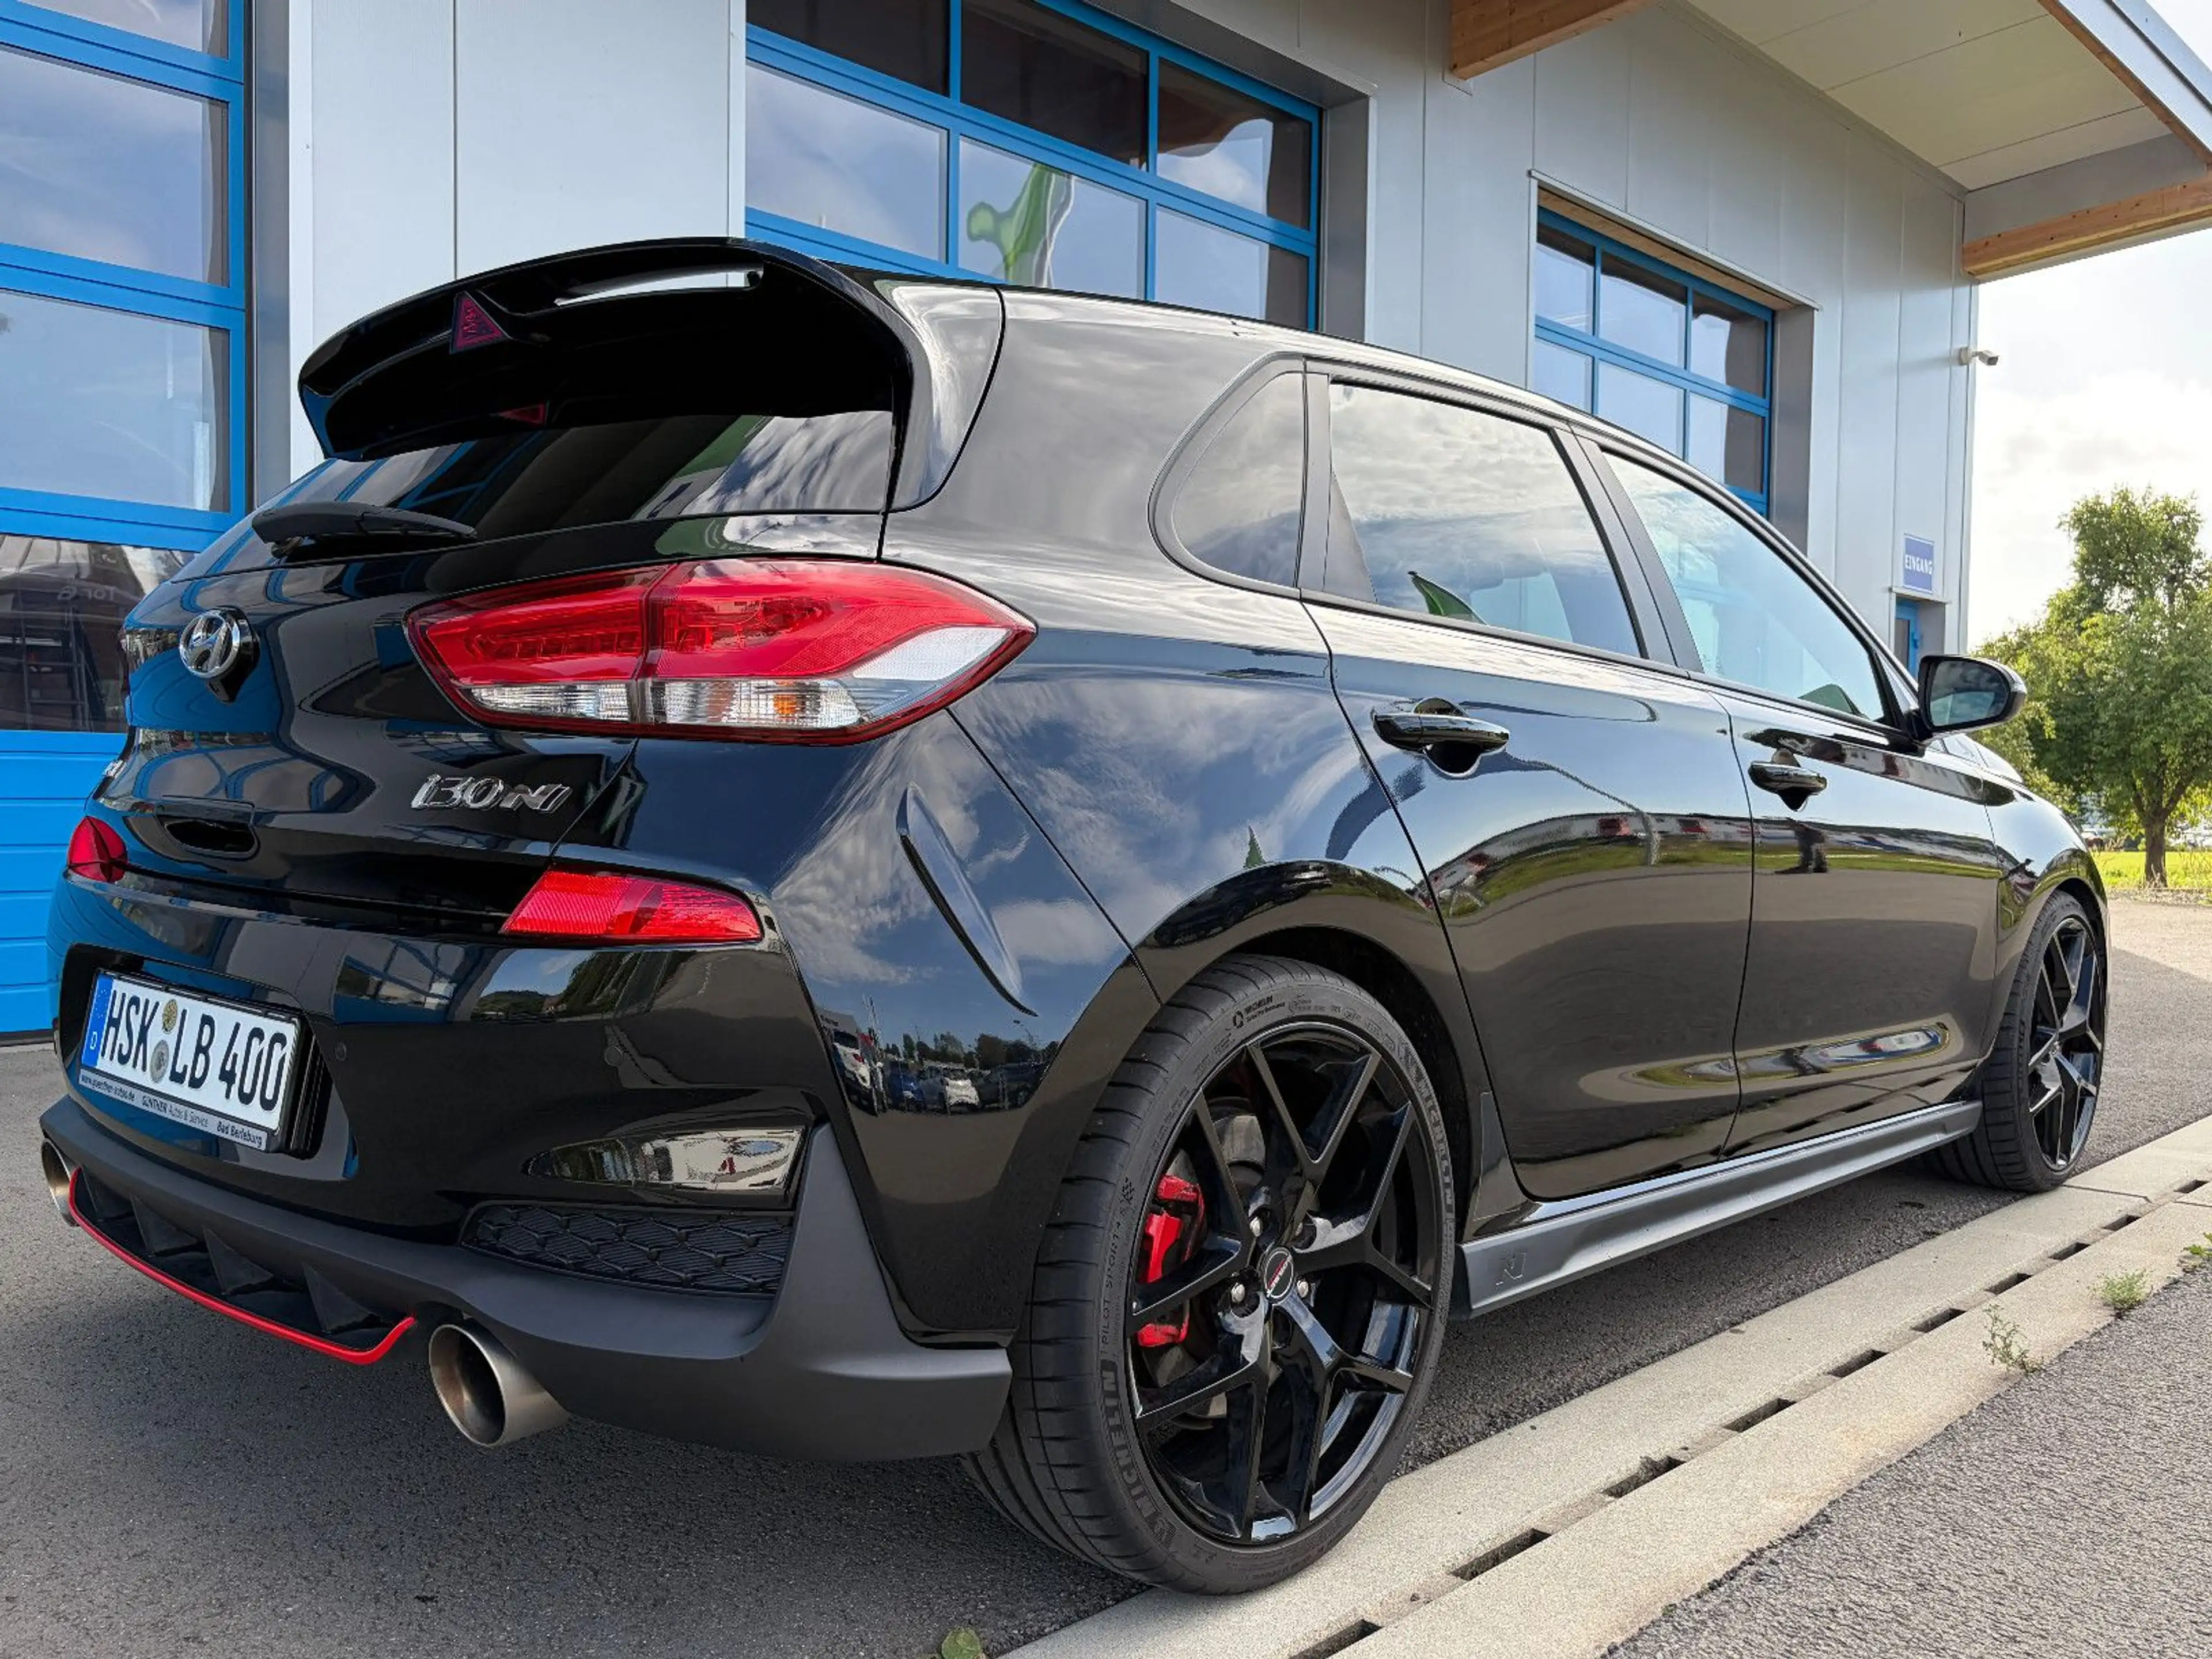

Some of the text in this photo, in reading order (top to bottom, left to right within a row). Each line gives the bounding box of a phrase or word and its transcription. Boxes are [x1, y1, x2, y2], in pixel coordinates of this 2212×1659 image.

[1905, 554, 1932, 574] EINGANG
[90, 1031, 97, 1050] D
[101, 990, 287, 1112] HSK LB 400
[217, 1120, 229, 1134] Bad
[1101, 1300, 1112, 1344] PILOT
[1102, 1369, 1156, 1519] MICHELIN
